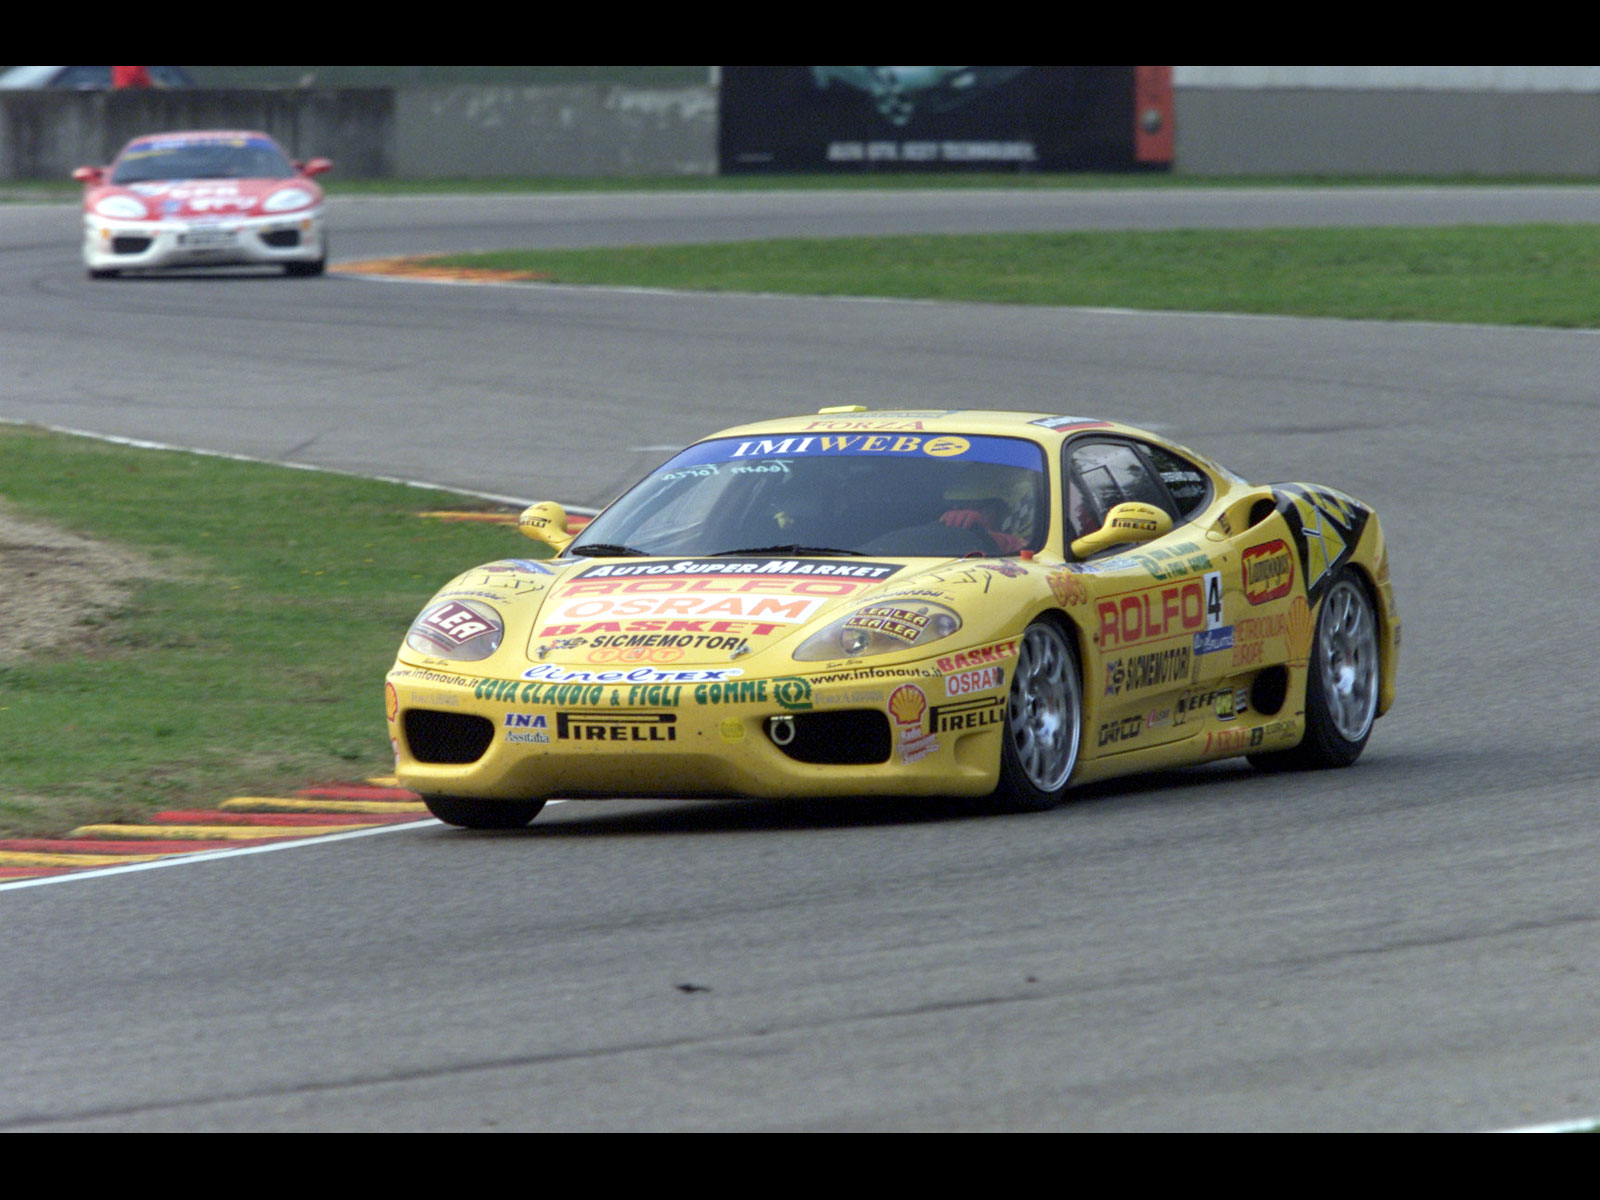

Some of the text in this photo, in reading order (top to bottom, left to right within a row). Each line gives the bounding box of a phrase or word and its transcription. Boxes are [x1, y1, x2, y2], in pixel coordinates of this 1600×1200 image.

[805, 421, 924, 431] FORZA
[560, 580, 858, 598] ROLFO
[1208, 576, 1222, 622] 4
[563, 597, 812, 619] OSRAM
[859, 606, 928, 626] LEA LEA
[1098, 583, 1204, 646] ROLFO
[427, 603, 488, 639] LEA
[540, 620, 786, 638] BASKET
[848, 617, 918, 638] LEA LEA
[590, 634, 748, 650] SICMEMOTORI
[937, 641, 1017, 673] BASKET
[809, 666, 943, 685] www.infonauta.it
[521, 682, 604, 706] CLAUDIO
[610, 689, 620, 706] &
[628, 685, 683, 706] FIGLI
[694, 680, 768, 705] GOMME
[504, 713, 547, 728] INA
[930, 696, 1006, 733] PIRELLI
[556, 711, 677, 741] PIRELLI
